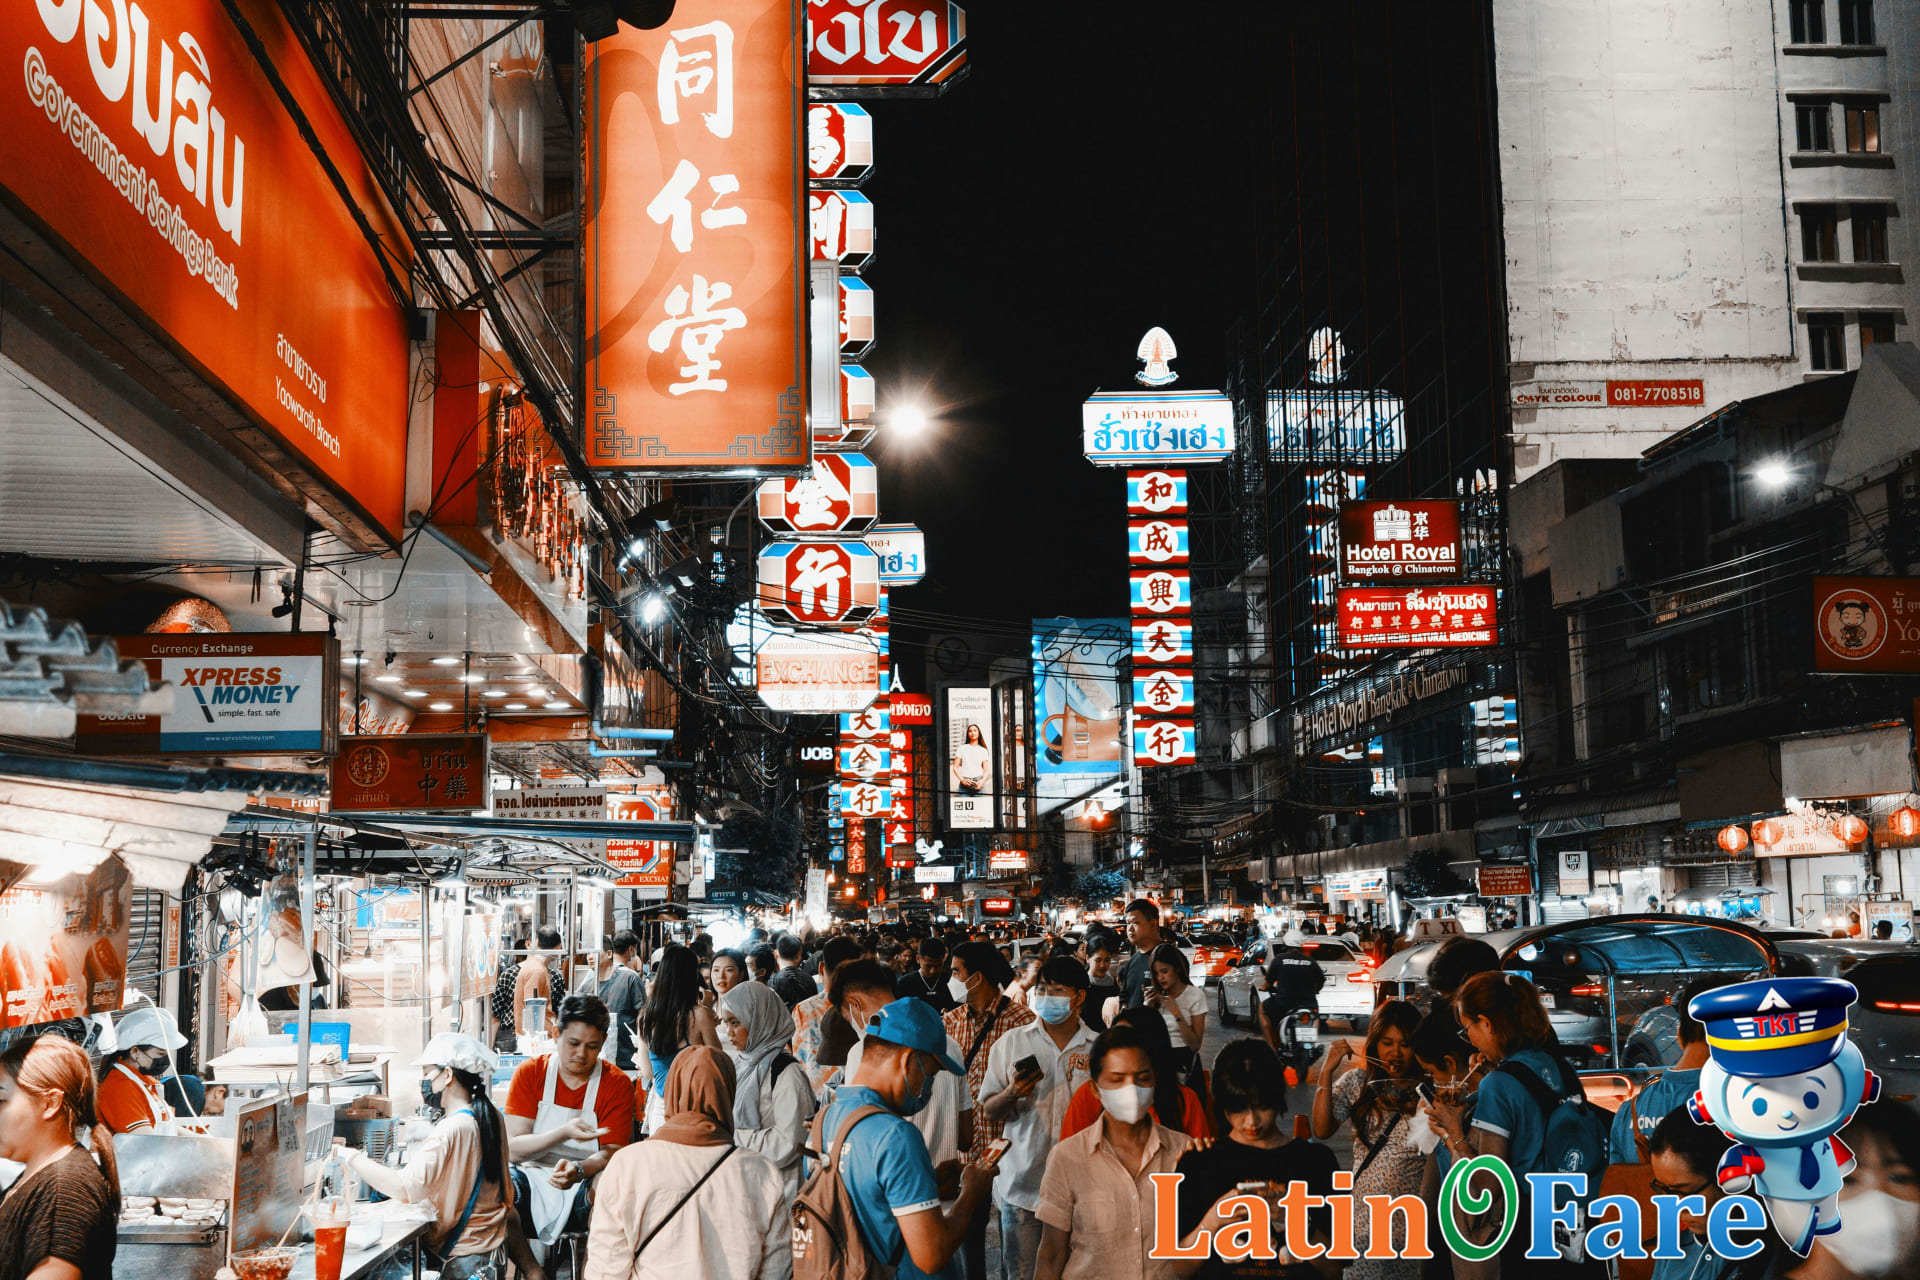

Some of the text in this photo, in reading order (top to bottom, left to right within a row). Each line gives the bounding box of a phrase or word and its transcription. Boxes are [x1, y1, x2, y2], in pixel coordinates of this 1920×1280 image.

[24, 46, 238, 310] Government Savings Bank
[646, 20, 748, 396] 同仁堂
[1555, 393, 1601, 403] COLOUR
[1614, 387, 1701, 402] 081-7708518
[275, 375, 341, 459] Yaowarath Branch
[1121, 404, 1198, 420] ห้างขายทอง
[1093, 412, 1226, 451] ฮั่วเซ่งเฮง
[1346, 542, 1456, 562] Hotel Royal
[1348, 564, 1456, 577] Bangkok @ Chinatown
[1346, 597, 1401, 612] ร้านขายยา
[1143, 476, 1181, 759] 和成興大金行
[1411, 630, 1449, 643] NATURAL
[1449, 630, 1491, 642] MEDICINE
[151, 643, 254, 655] Currency Exchange
[180, 667, 283, 687] XPRESS
[759, 660, 877, 684] EXCHANGE
[211, 685, 301, 705] MONEY
[1311, 703, 1338, 742] Hotel
[1339, 689, 1369, 732] Royal
[1370, 674, 1409, 722] Bangkok
[1414, 660, 1468, 700] Chinatown
[218, 708, 281, 718] simple. fast. safe
[421, 747, 468, 769] ยาจีน
[800, 746, 834, 761] UOB
[742, 890, 749, 901] 9
[1419, 921, 1458, 936] TXI
